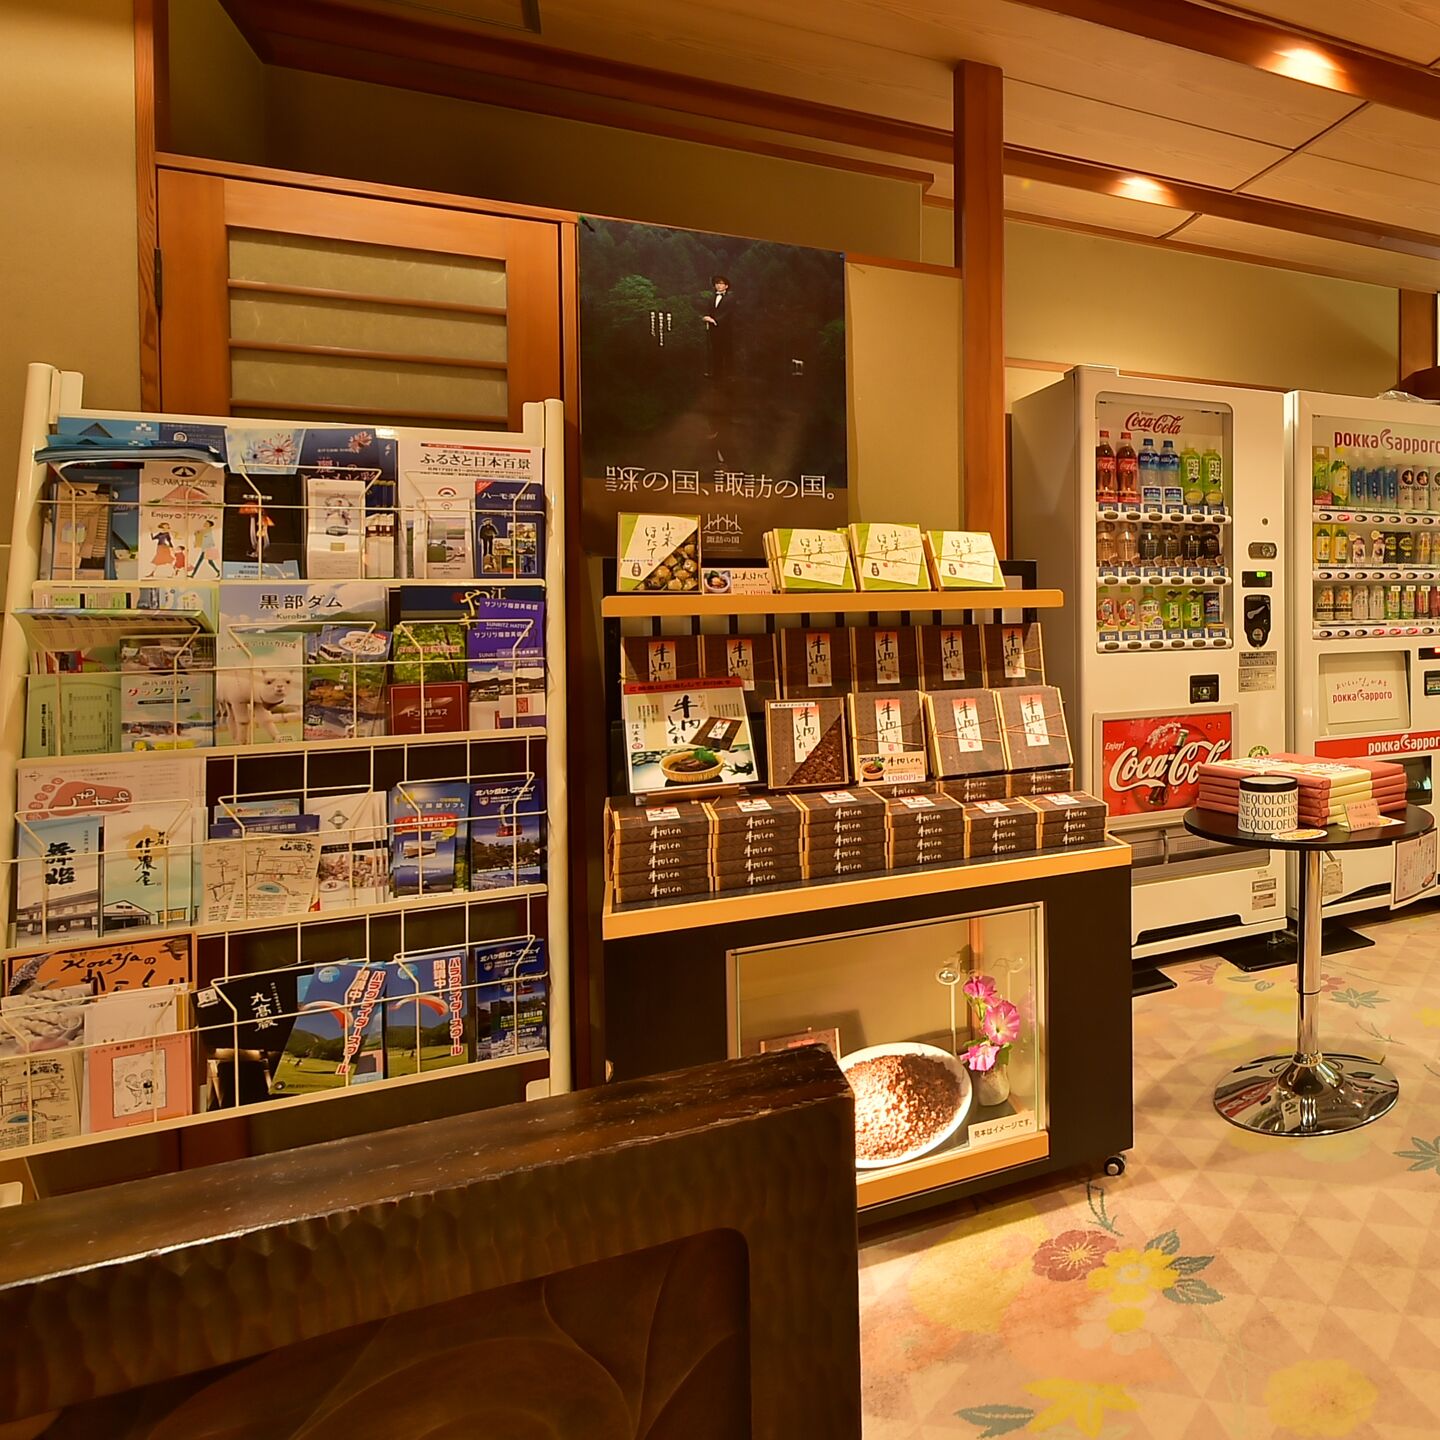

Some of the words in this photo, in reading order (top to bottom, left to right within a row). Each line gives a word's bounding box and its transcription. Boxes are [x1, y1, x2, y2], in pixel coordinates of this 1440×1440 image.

[1125, 411, 1184, 435] Coca-Cola
[420, 453, 531, 470] ふるさと日本百景
[605, 466, 835, 500] 謎の国、諏訪の国。
[259, 594, 342, 609] 黒部ダム
[1105, 741, 1125, 751] Enjoy!
[250, 992, 279, 1032] 丸高蔵
[449, 957, 463, 1057] パラグライダースクール
[974, 1118, 1033, 1138] 見本はイメージです。
